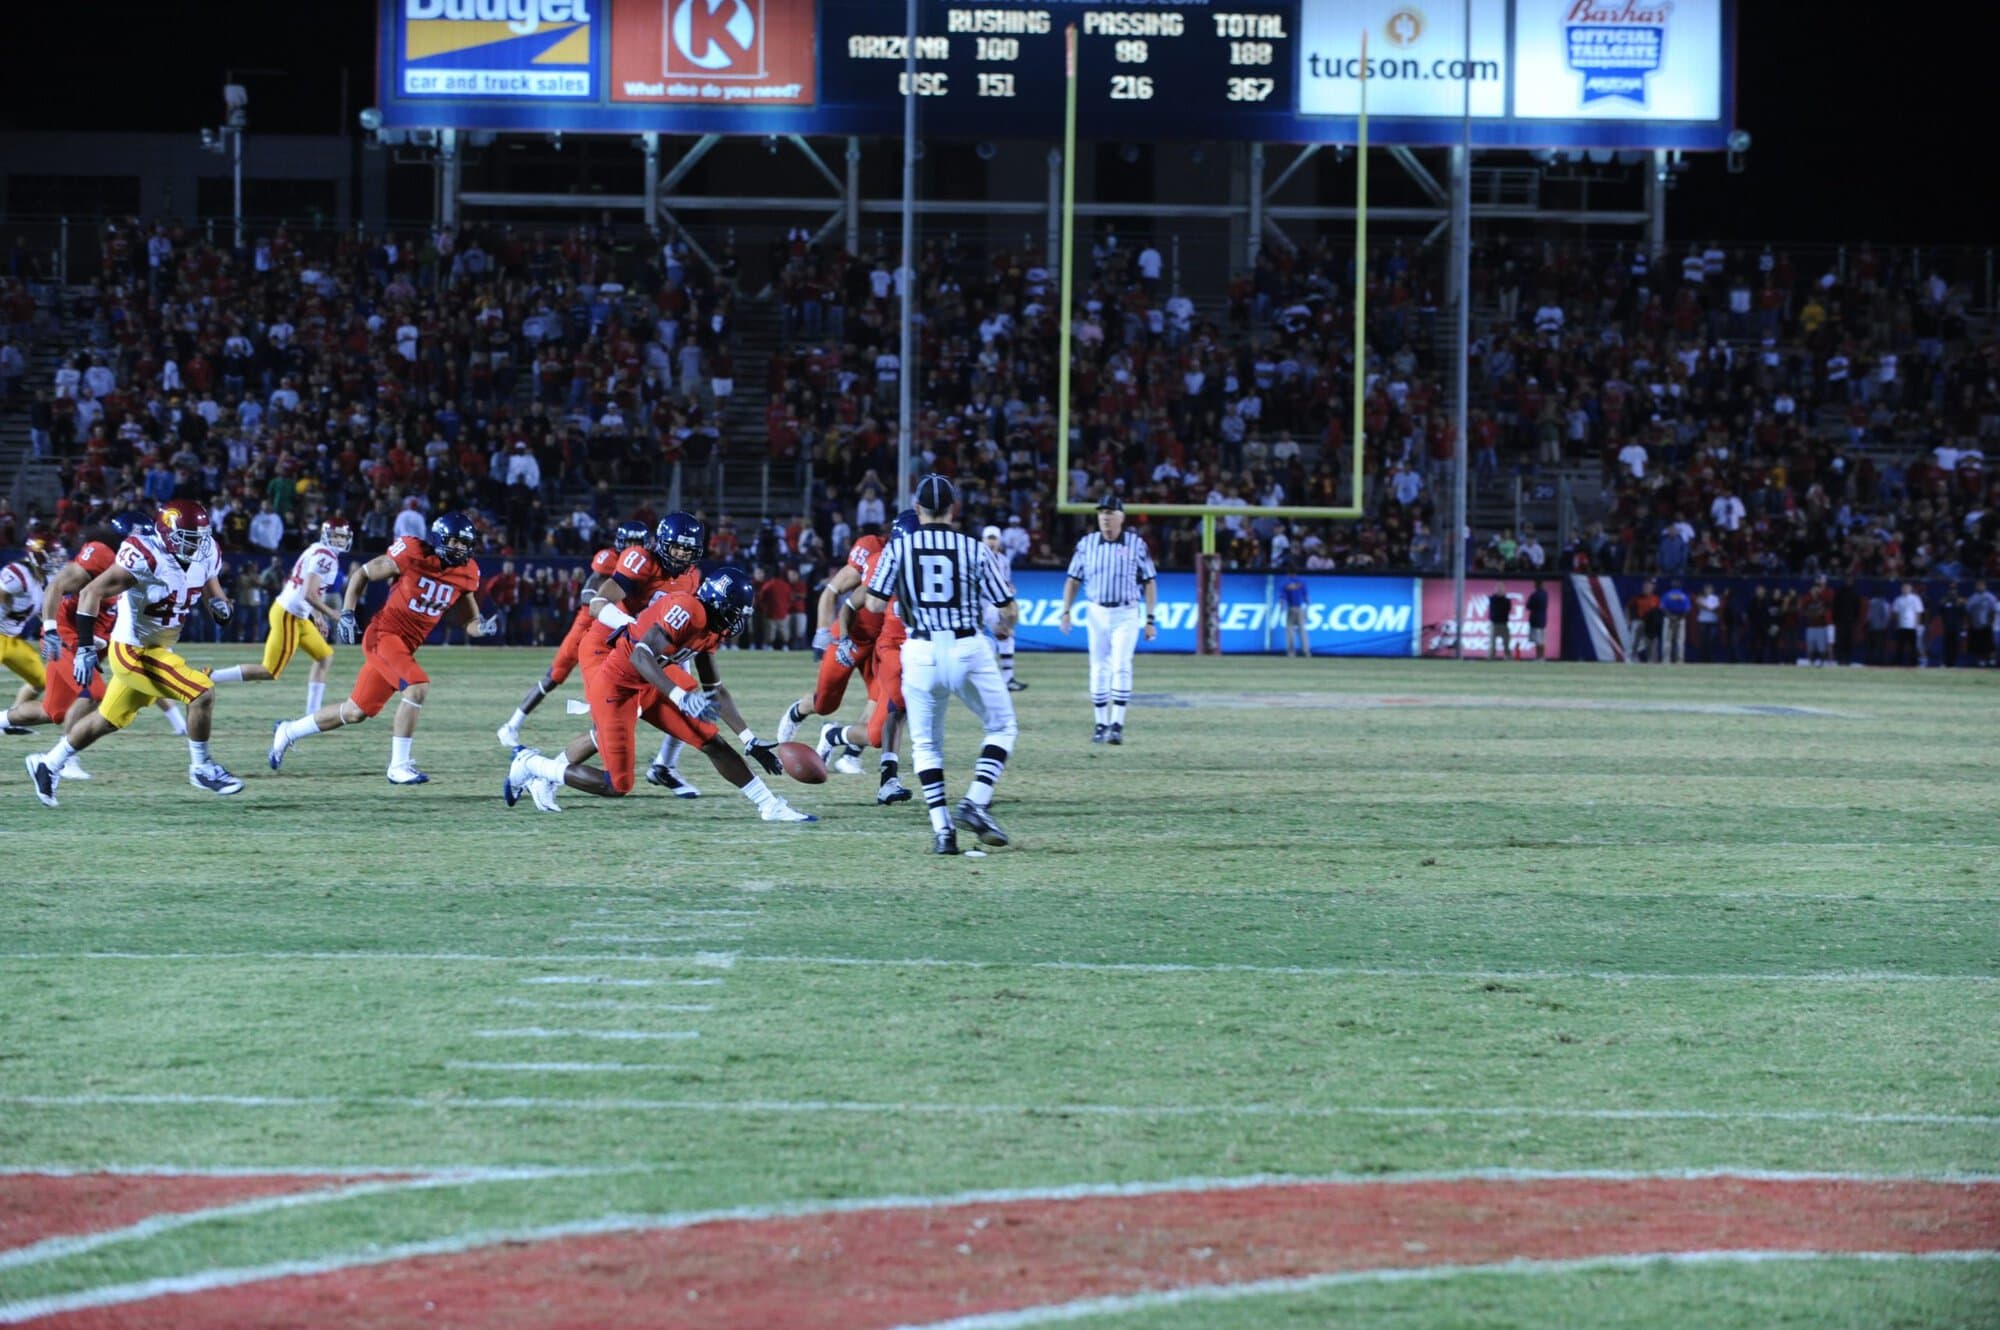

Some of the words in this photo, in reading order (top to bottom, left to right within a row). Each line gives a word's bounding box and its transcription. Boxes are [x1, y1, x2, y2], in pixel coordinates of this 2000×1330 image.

[948, 9, 1050, 34] RUSHING
[1084, 12, 1184, 36] PASSING
[1213, 14, 1287, 38] TOTAL
[1571, 29, 1659, 44] OFFICIAL
[976, 37, 1019, 60] 100
[1115, 40, 1148, 63] 88
[1230, 42, 1273, 65] 188
[1308, 53, 1498, 80] tucson.com
[410, 77, 438, 90] car
[445, 75, 478, 90] and
[485, 75, 530, 91] truck
[537, 77, 585, 92] sales
[624, 81, 665, 96] What
[701, 83, 721, 97] do
[723, 86, 751, 100] you
[753, 84, 802, 98] need?
[899, 72, 949, 96] USC
[977, 73, 1015, 97] 151
[1110, 75, 1154, 99] 216
[1227, 77, 1274, 101] 367
[118, 547, 140, 569] 45
[623, 550, 647, 574] 81
[919, 555, 954, 602] B
[408, 576, 455, 617] 38
[663, 604, 690, 631] 89
